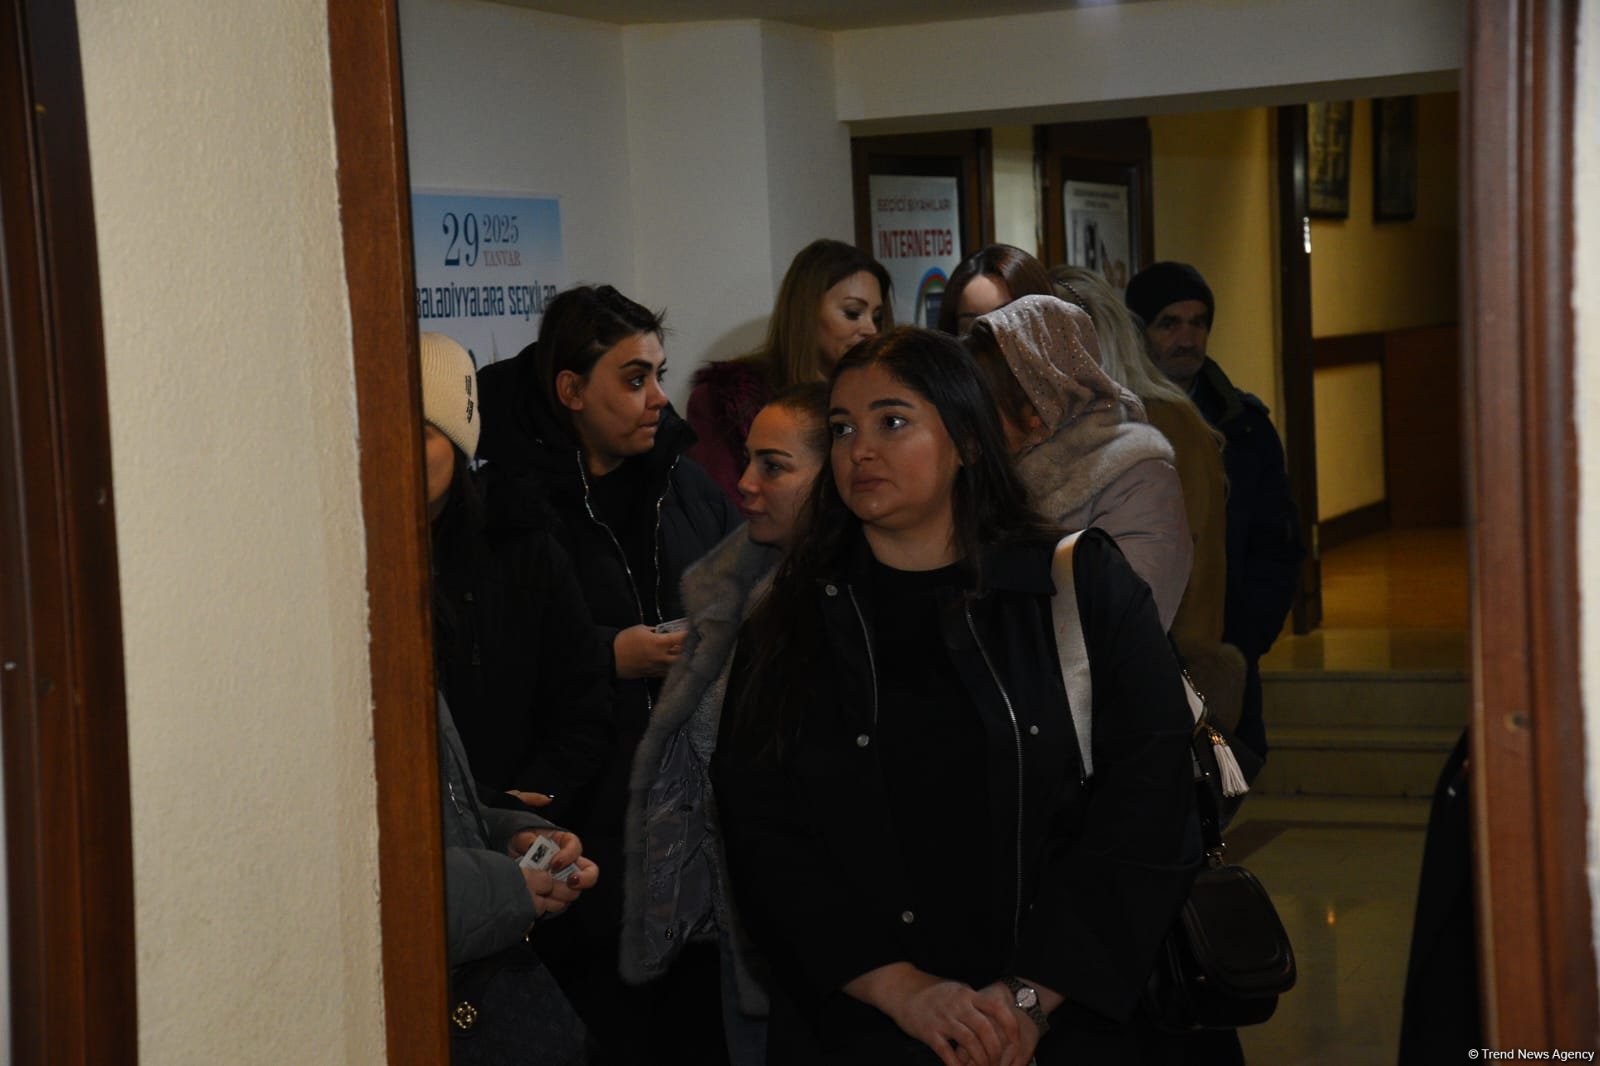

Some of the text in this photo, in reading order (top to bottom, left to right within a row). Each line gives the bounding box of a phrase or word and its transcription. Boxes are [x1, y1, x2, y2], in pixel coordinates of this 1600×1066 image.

[443, 212, 519, 267] 29 2025
[484, 250, 521, 267] YANVAR
